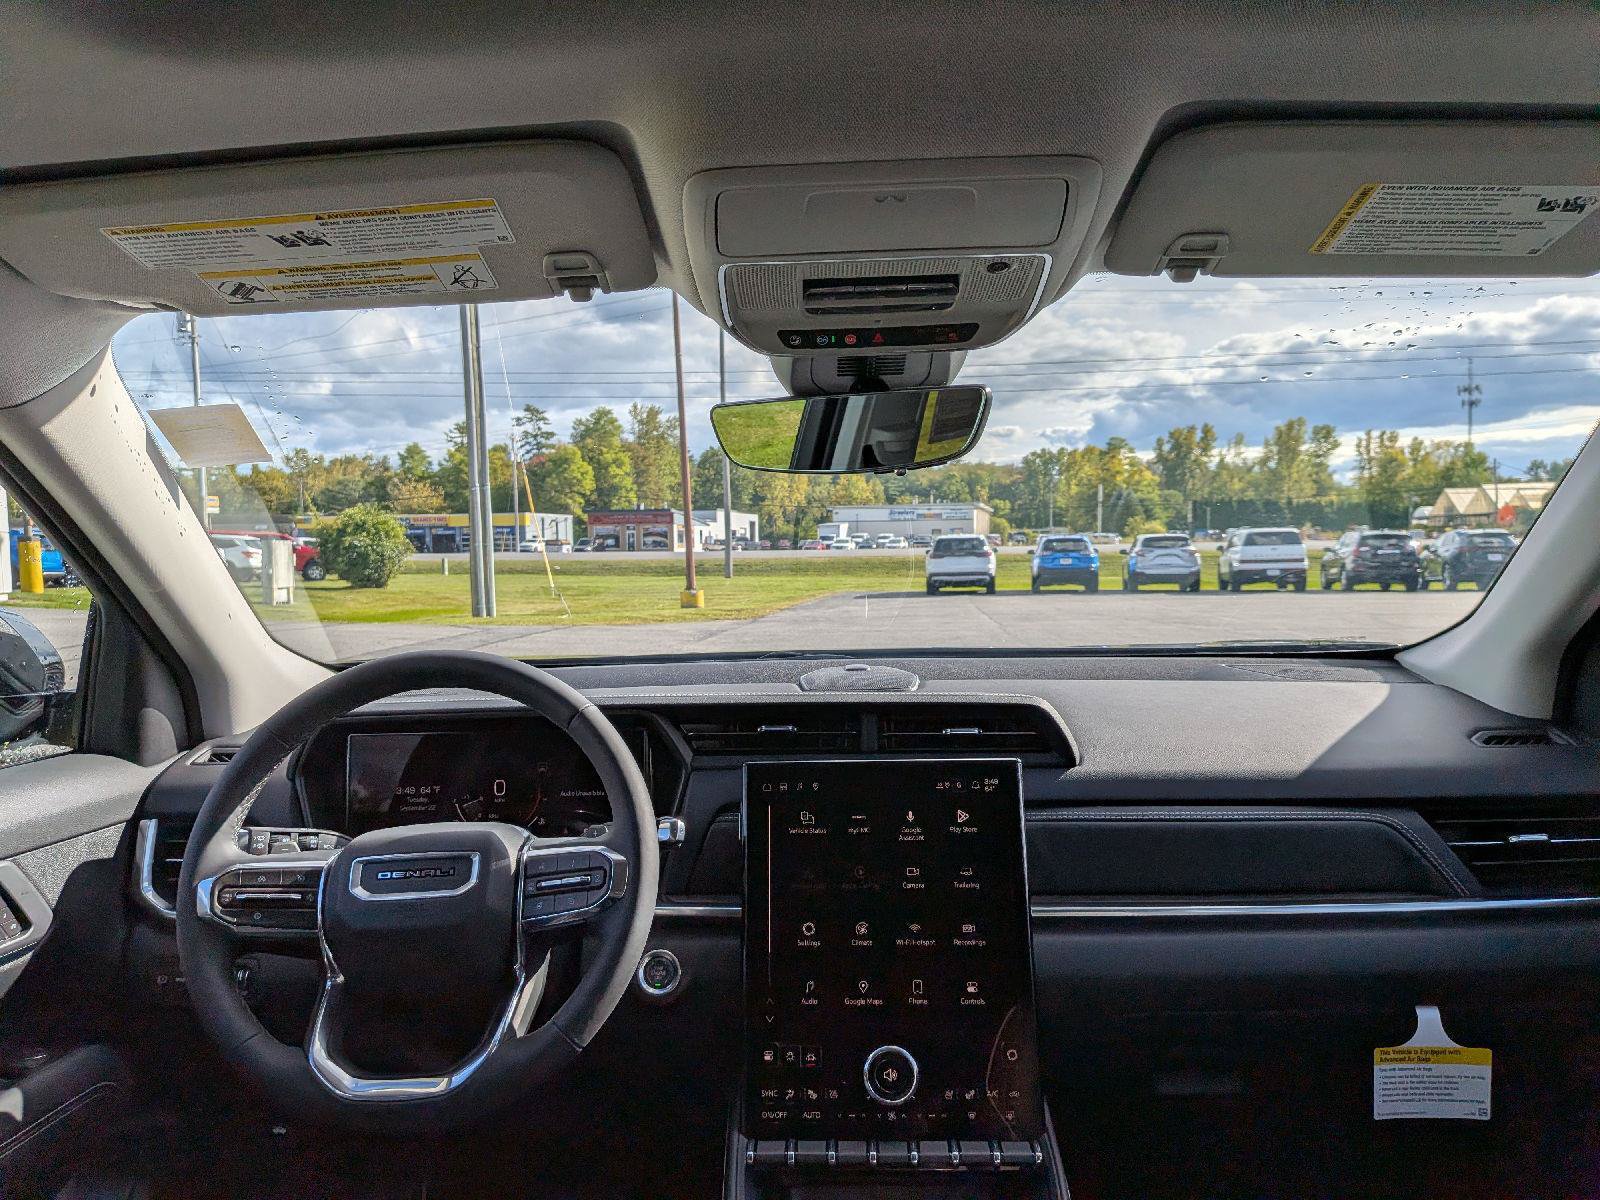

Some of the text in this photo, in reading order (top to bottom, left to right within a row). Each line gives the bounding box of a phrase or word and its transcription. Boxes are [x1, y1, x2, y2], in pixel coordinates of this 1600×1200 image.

[494, 779, 506, 796] 0
[377, 866, 456, 880] DENALI
[802, 1111, 821, 1119] AUTO
